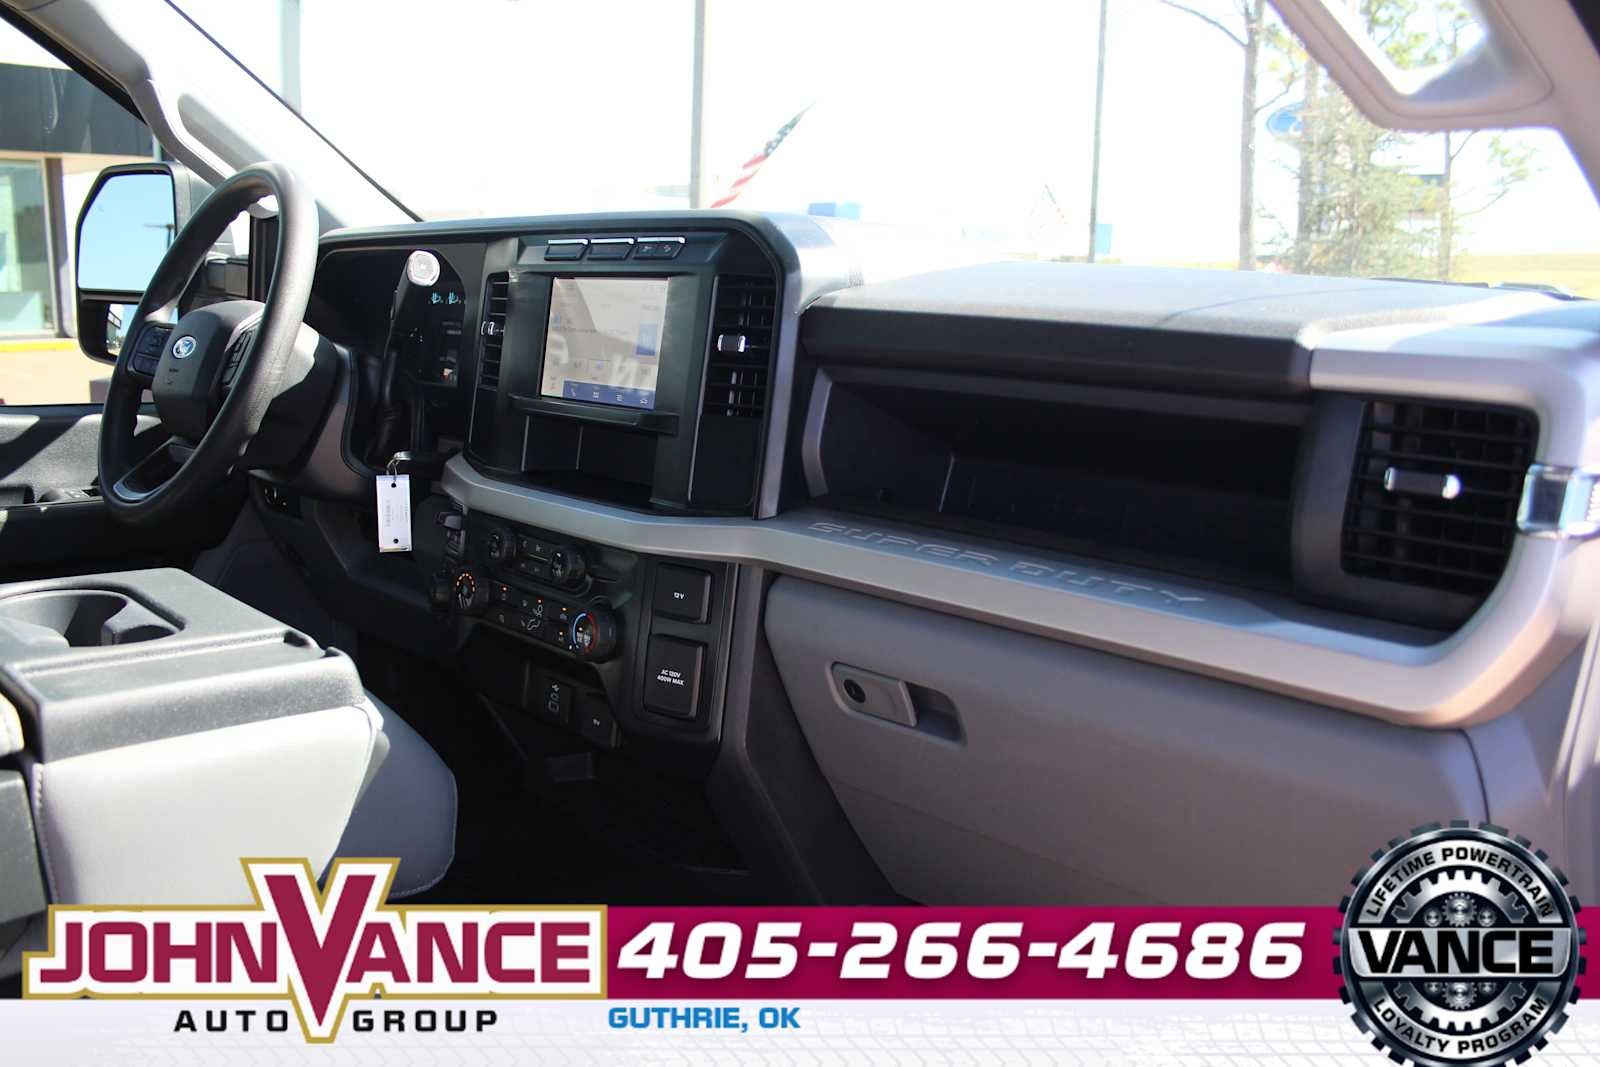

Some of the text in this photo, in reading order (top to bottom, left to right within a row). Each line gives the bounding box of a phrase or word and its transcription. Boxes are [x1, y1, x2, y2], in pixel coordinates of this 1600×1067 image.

[807, 521, 1206, 603] SUPER DUTY
[672, 677, 684, 685] MAX
